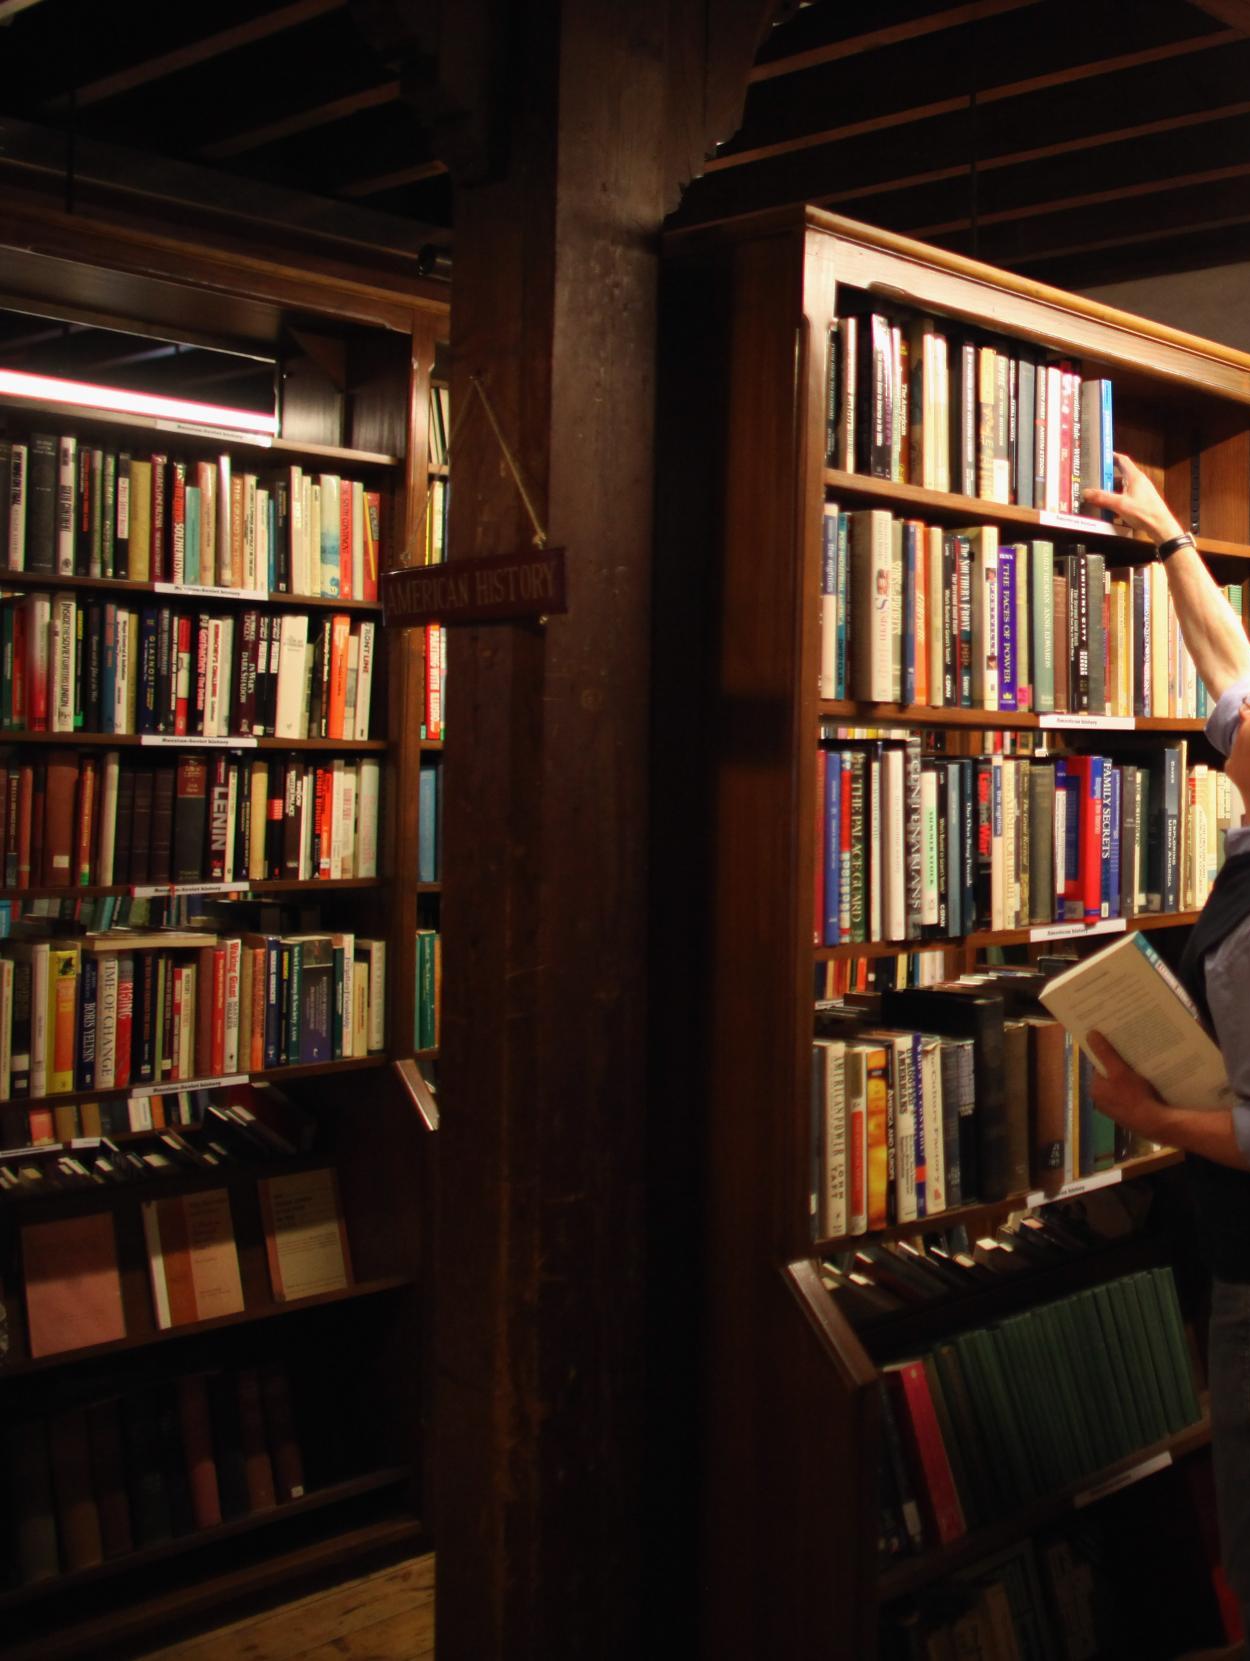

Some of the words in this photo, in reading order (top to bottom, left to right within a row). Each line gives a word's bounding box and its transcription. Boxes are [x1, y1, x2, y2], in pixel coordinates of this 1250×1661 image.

[827, 543, 836, 559] the
[960, 543, 971, 558] The
[386, 572, 470, 616] AMERICAN
[475, 561, 558, 606] HISTORY
[827, 559, 836, 593] eighties
[960, 559, 971, 601] SOUTHERN
[1003, 563, 1011, 587] THE
[61, 603, 73, 625] INSIDE
[960, 603, 971, 632] FRONT
[1003, 590, 1011, 623] FACES
[61, 636, 73, 659] SOVIET
[1003, 625, 1011, 639] OF
[240, 652, 249, 671] DARK
[1003, 642, 1011, 683] POWER
[61, 684, 73, 708] UNION
[240, 671, 249, 704] SHADOW
[428, 668, 440, 691] WITH
[851, 778, 863, 814] THE
[1102, 762, 1112, 807] FAMILY
[211, 786, 227, 851] LENIN
[911, 759, 921, 909] CENTENARIANS
[1102, 807, 1112, 860] SECRETS
[851, 815, 863, 871] PALACE
[978, 824, 990, 856] War
[851, 872, 863, 923] GUARD
[1071, 927, 1089, 935] history
[228, 942, 239, 974] Waking
[229, 975, 238, 998] Giant
[291, 965, 299, 994] Economy
[84, 1002, 96, 1028] BORIS
[101, 993, 117, 1014] OF
[118, 981, 133, 1020] RISING
[290, 1001, 298, 1025] Society
[83, 1028, 95, 1064] YELTSIN
[101, 1015, 117, 1077] CHANGE
[831, 1055, 844, 1115] AMERICAN
[897, 1050, 908, 1115] AMERICANS
[930, 1069, 938, 1123] Culture
[886, 1089, 895, 1128] AMERICA
[831, 1116, 844, 1157] POWER
[886, 1129, 895, 1147] AND
[886, 1148, 895, 1181] EUROPE
[932, 1127, 940, 1184] Factory
[830, 1166, 838, 1200] TAFT
